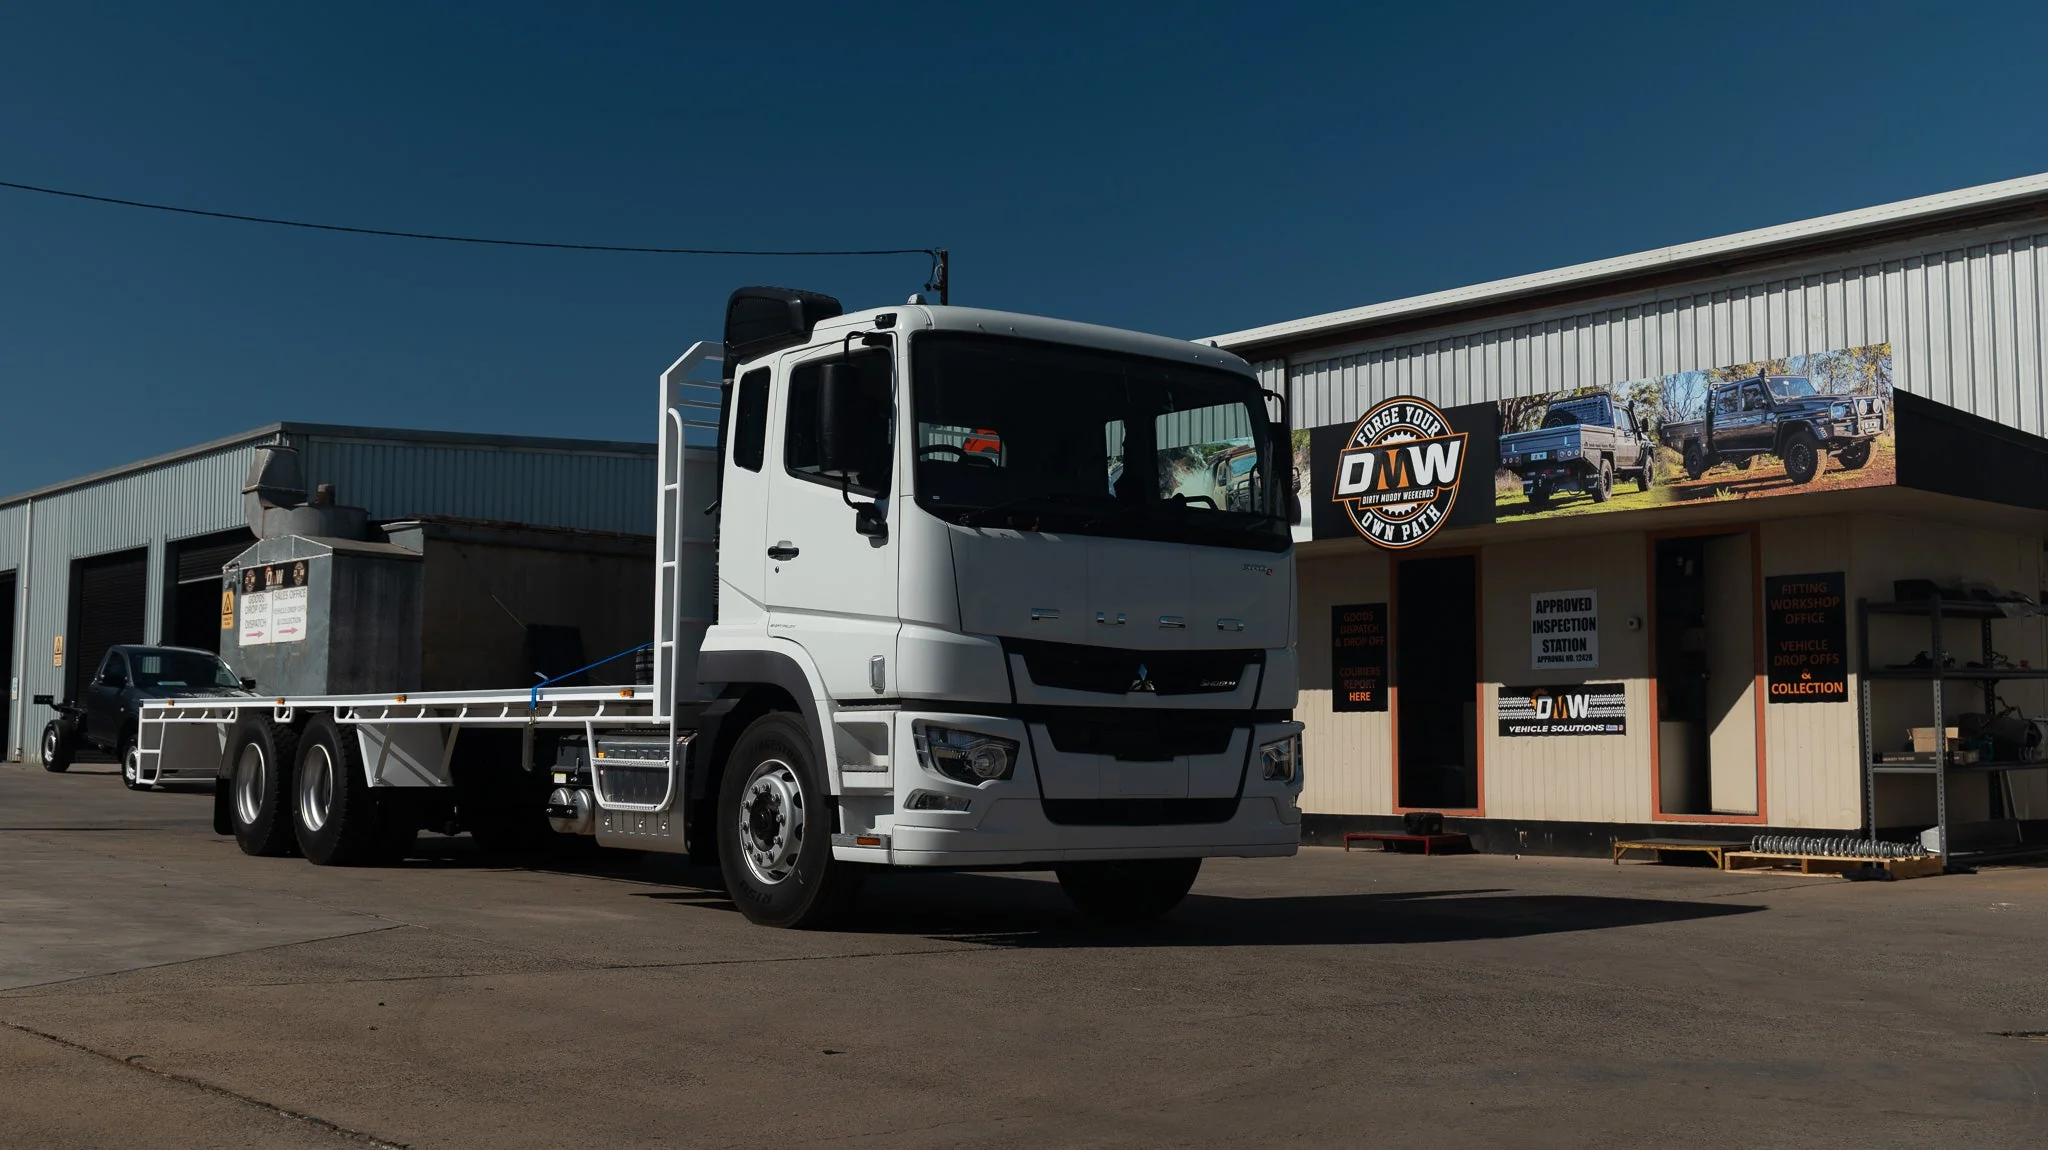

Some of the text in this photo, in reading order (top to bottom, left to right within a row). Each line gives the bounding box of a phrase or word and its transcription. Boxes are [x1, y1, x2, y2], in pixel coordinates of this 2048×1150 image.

[1356, 406, 1441, 447] FORGE YOUR
[1338, 440, 1461, 495] DMW
[1362, 488, 1435, 505] DIRTY MUDDY WEEKENDS
[1361, 504, 1441, 541] OWN PATH
[1782, 582, 1828, 595] FITTING
[1536, 597, 1592, 614] APPROVED
[1771, 597, 1840, 611] WORKSHOP
[1031, 608, 1245, 632] FUSO
[1343, 611, 1374, 622] GOODS
[1785, 613, 1825, 625] OFFICE
[1340, 623, 1379, 634] DISPATCH
[1532, 617, 1596, 634] INSPECTION
[1369, 636, 1385, 647] OFF
[1542, 637, 1587, 653] STATION
[1780, 640, 1828, 652] VEHICLE
[1537, 655, 1564, 663] APPROVAL
[1774, 652, 1840, 666] DROP OFFS
[1801, 668, 1812, 680] &
[1343, 679, 1376, 689] REPORT
[1771, 681, 1844, 695] COLLECTION
[1349, 691, 1371, 702] HERE
[1536, 694, 1590, 720] DMW
[1509, 725, 1549, 733] VEHICLE
[1550, 724, 1605, 732] SOLUTIONS
